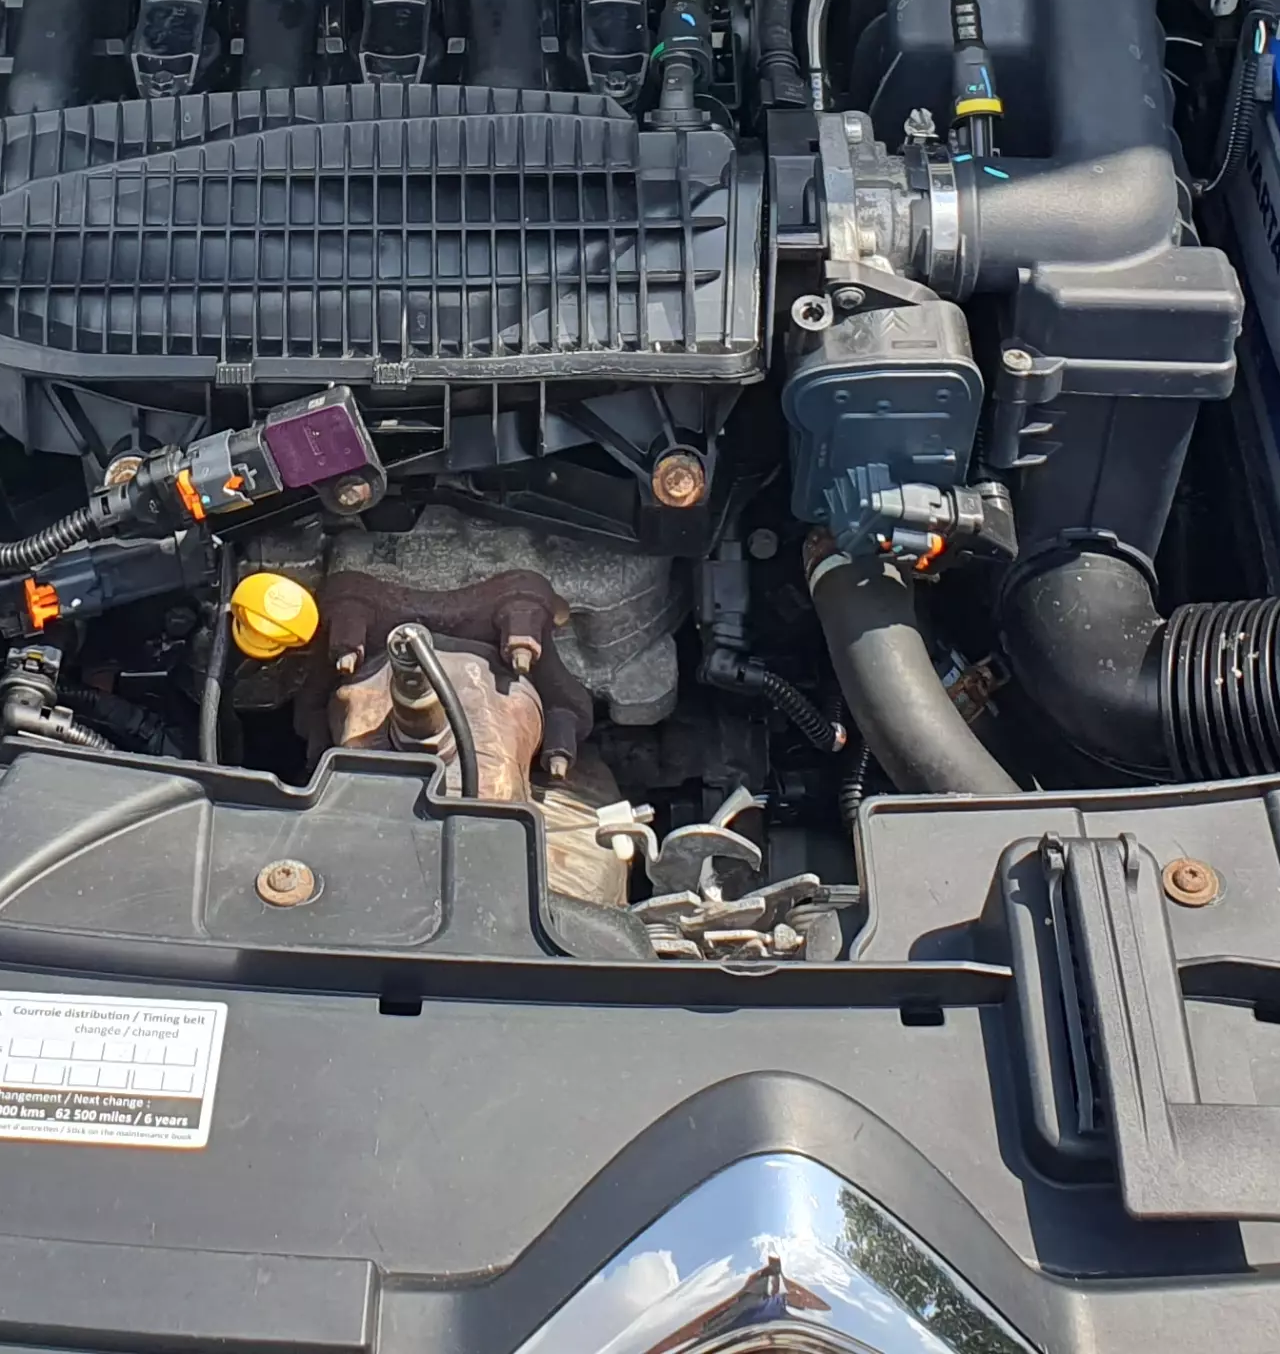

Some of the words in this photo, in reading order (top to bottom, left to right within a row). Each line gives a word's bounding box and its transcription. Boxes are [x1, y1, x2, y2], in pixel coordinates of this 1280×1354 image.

[13, 1005, 62, 1018] Courroie
[64, 1007, 130, 1021] distribution
[132, 1011, 140, 1023] /
[143, 1012, 180, 1025] Timing
[183, 1014, 205, 1025] belt
[74, 1024, 121, 1037] changée
[123, 1026, 131, 1038] /
[132, 1027, 179, 1039] changed
[64, 1092, 72, 1105] /
[73, 1093, 100, 1106] Next
[103, 1095, 144, 1109] change
[20, 1106, 46, 1118] kms
[74, 1108, 96, 1122] 500
[99, 1110, 132, 1124] miles
[133, 1112, 142, 1125] /
[144, 1113, 152, 1124] 6
[155, 1114, 188, 1127] years
[101, 1128, 114, 1136] the
[116, 1129, 169, 1138] maintenance
